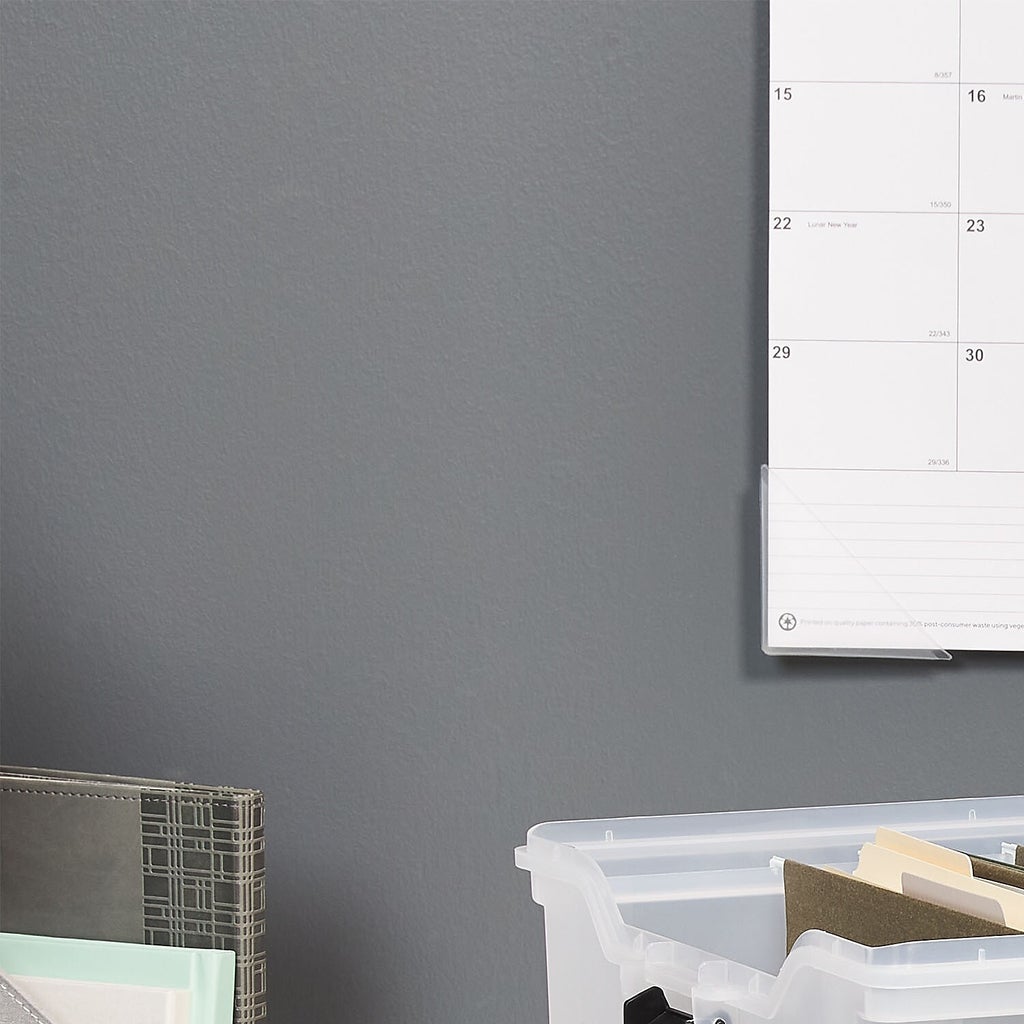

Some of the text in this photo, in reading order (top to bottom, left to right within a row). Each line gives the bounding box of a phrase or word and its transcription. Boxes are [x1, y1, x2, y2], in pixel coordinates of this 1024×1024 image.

[774, 88, 793, 101] 15
[968, 90, 987, 103] 16
[1002, 93, 1023, 101] Martin
[773, 217, 792, 230] 22
[966, 219, 986, 233] 23
[772, 346, 791, 359] 29
[965, 349, 984, 362] 30
[924, 621, 972, 630] post-consumer
[991, 621, 1009, 630] using
